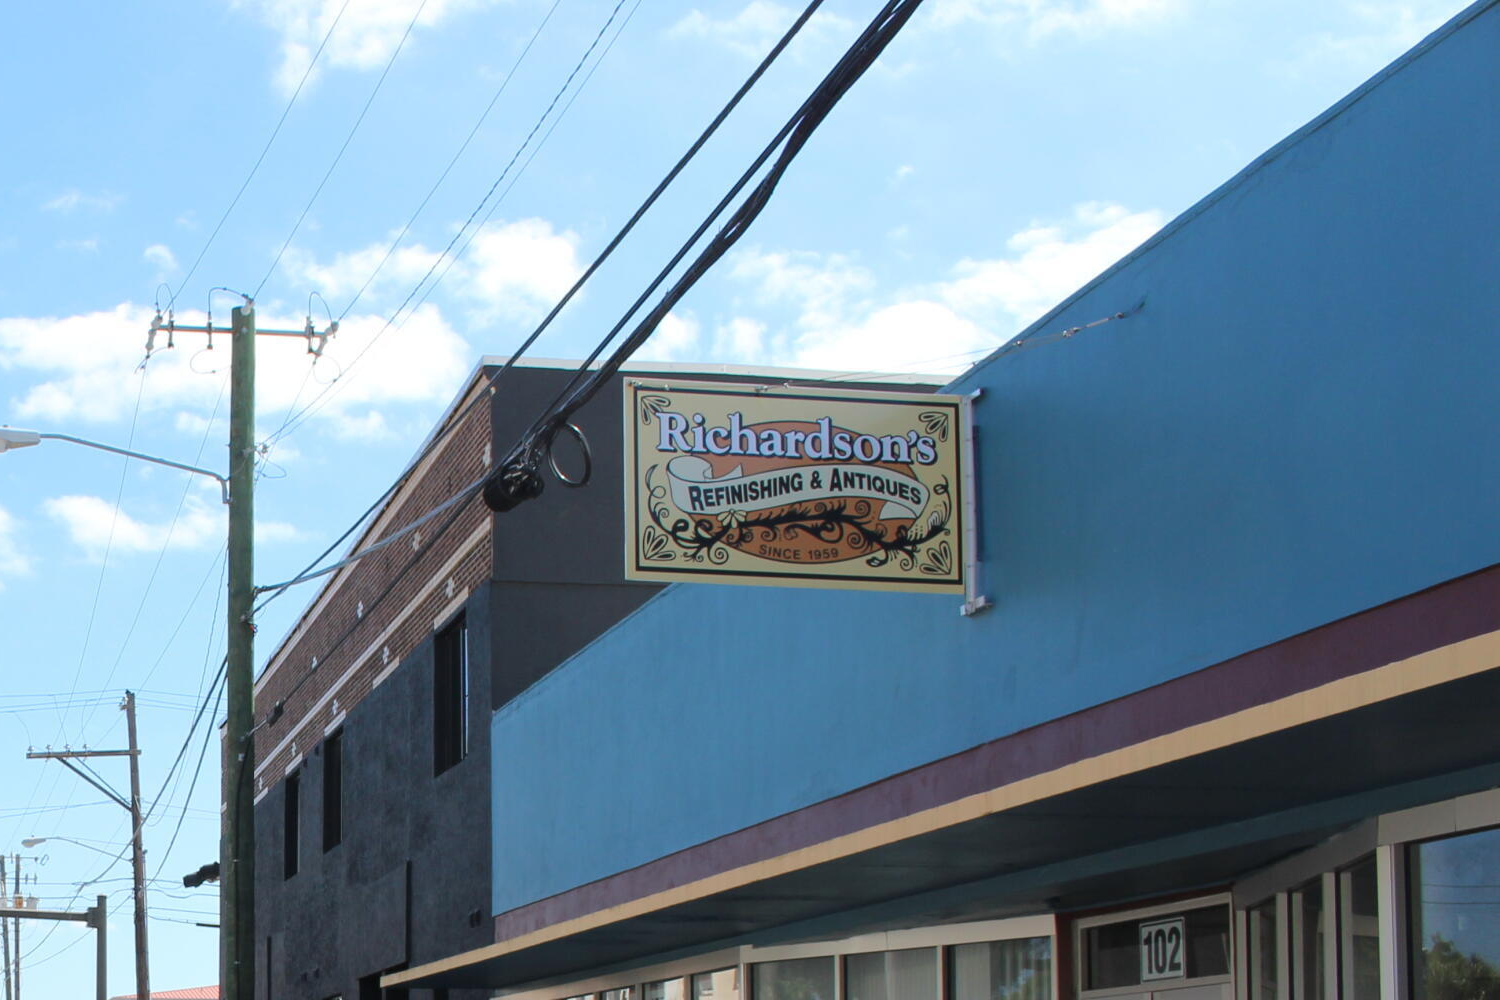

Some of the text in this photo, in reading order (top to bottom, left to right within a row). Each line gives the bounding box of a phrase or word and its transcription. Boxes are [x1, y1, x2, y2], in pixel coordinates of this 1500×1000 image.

[655, 411, 938, 465] Richardson's
[688, 468, 922, 511] REFINISHING & ANTIQUES
[759, 544, 839, 560] SINCE 1959
[1143, 926, 1182, 975] 102
